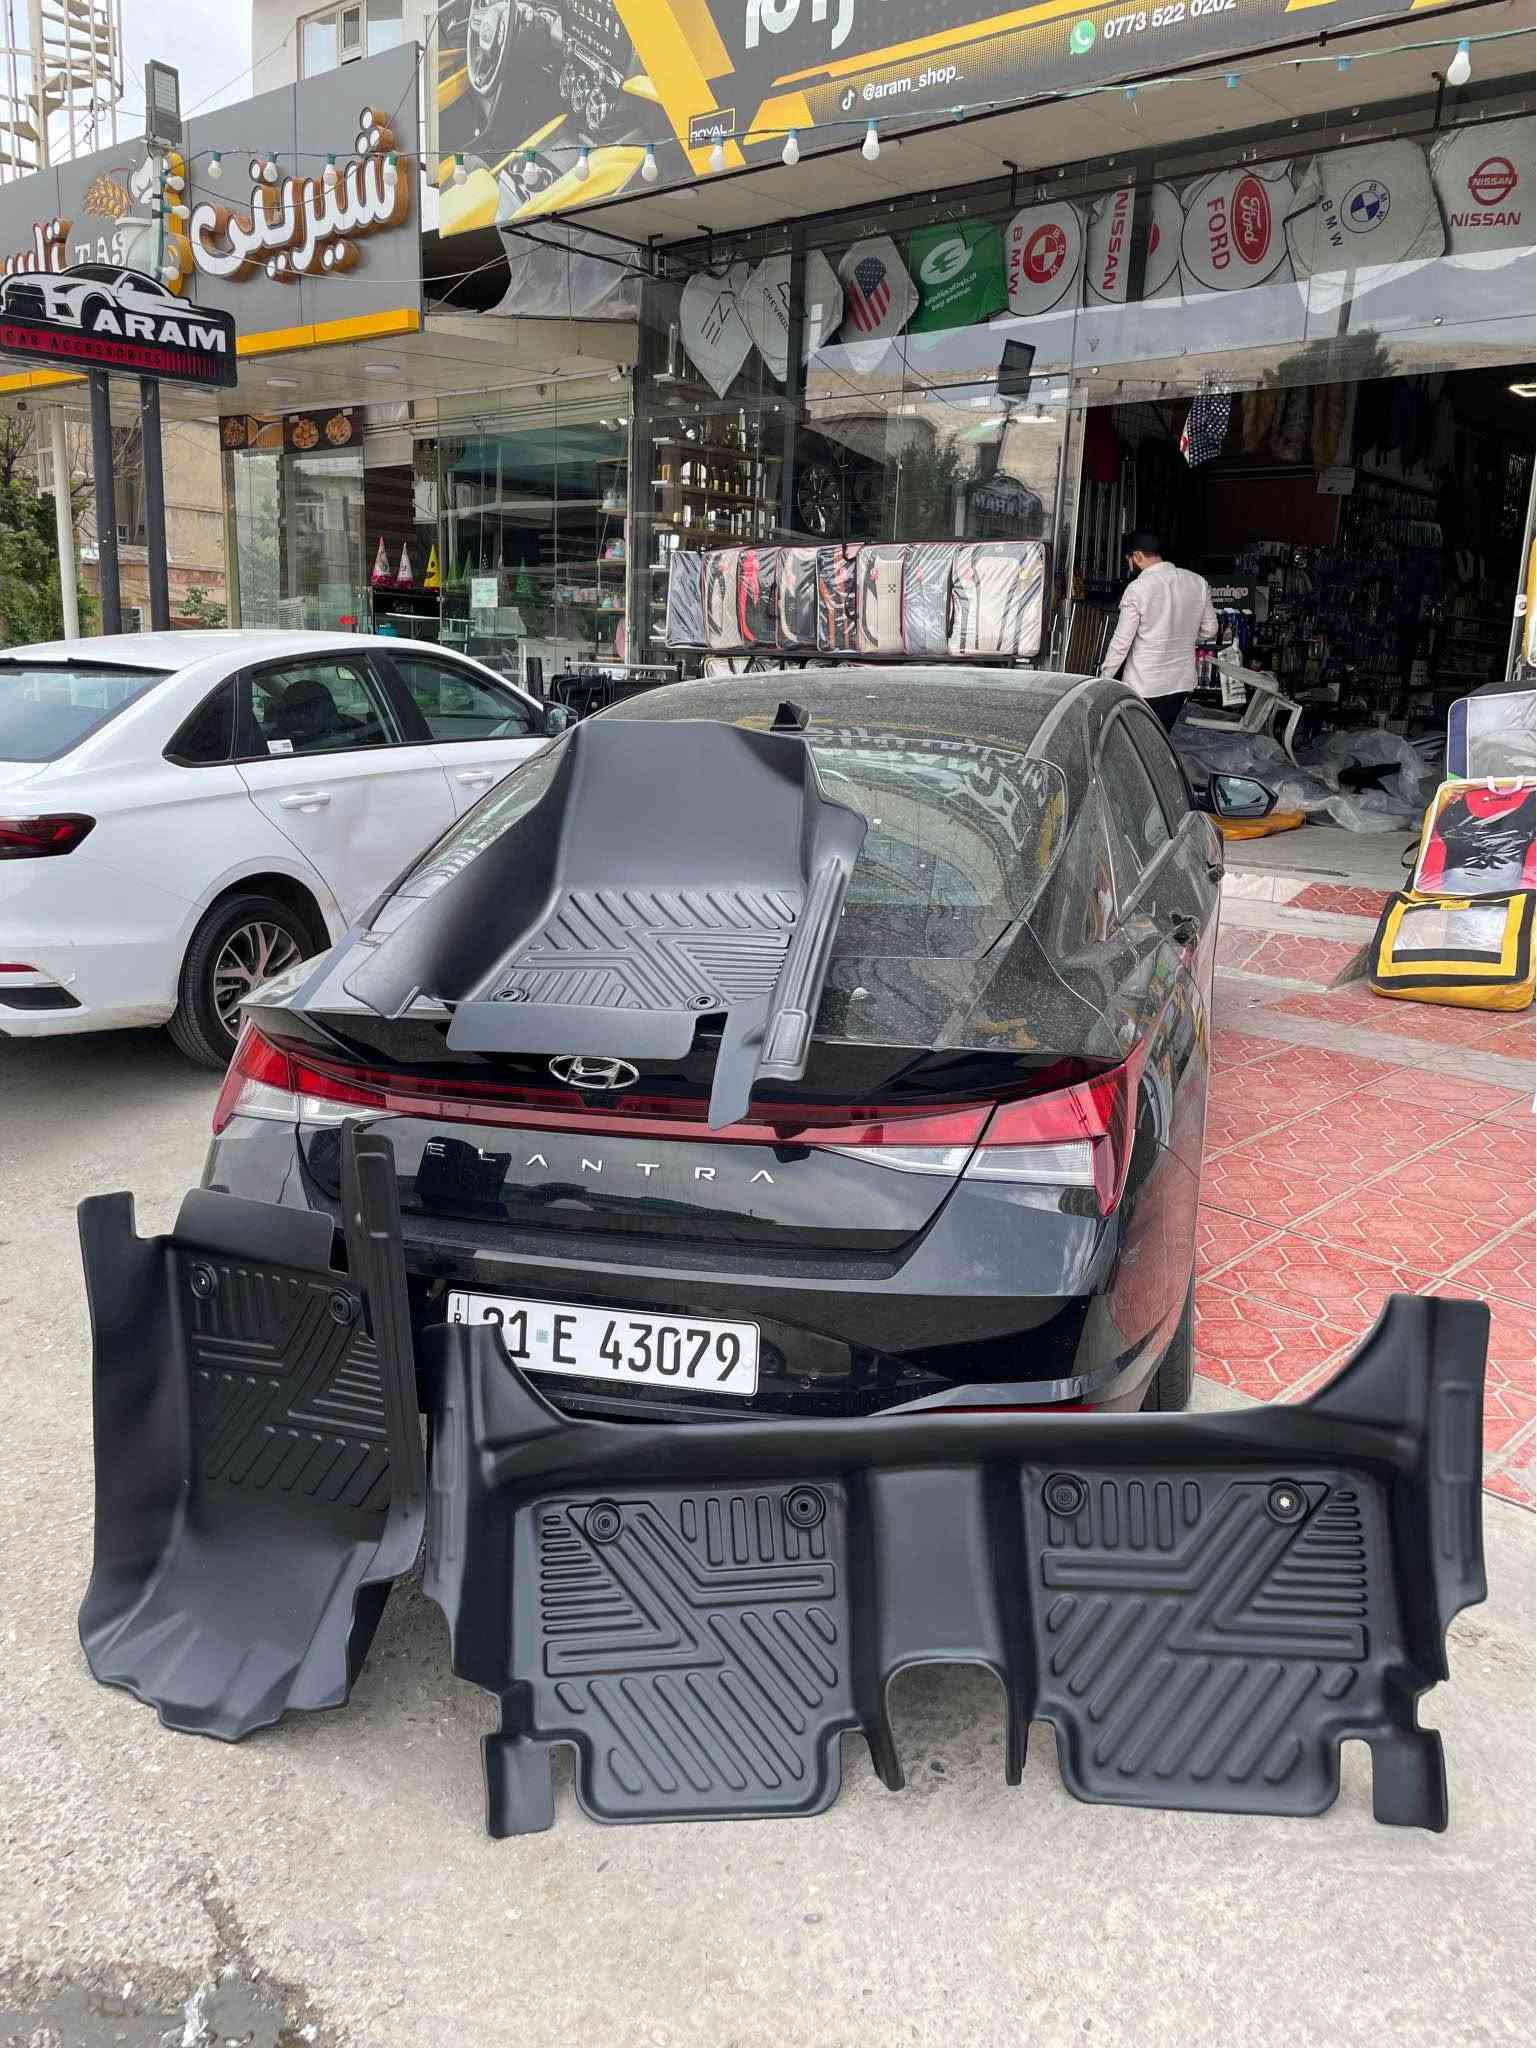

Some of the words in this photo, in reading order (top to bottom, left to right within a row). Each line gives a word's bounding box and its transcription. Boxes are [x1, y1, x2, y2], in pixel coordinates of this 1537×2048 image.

[1103, 11, 1147, 39] 0773
[1151, 3, 1185, 27] 522
[862, 63, 964, 100] @aram_shop_
[1470, 175, 1514, 189] NISSAN
[1102, 191, 1130, 290] NISSAN
[1207, 196, 1231, 270] FORD
[1239, 195, 1263, 245] Ford
[1450, 211, 1522, 227] NISSAN
[93, 308, 226, 353] ARAM
[425, 1141, 775, 1185] ELANTRA
[552, 1313, 577, 1365] E
[599, 1319, 741, 1382] 43079
